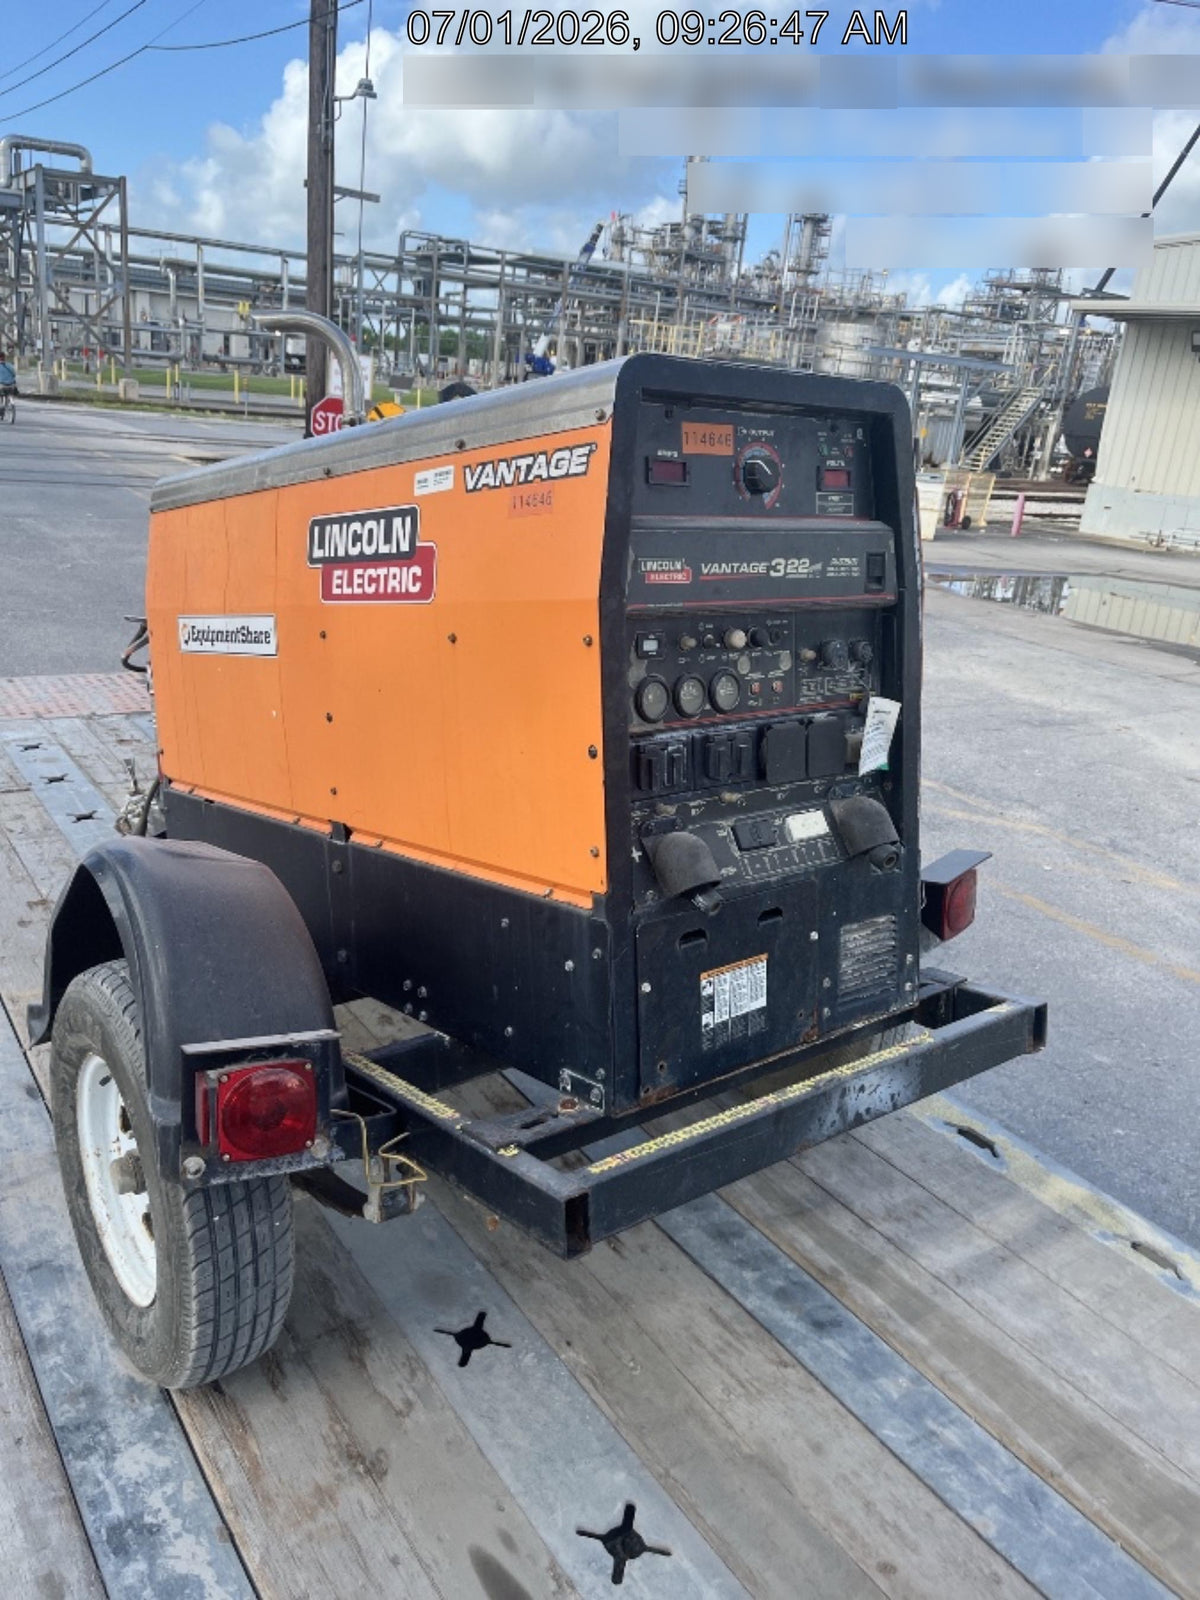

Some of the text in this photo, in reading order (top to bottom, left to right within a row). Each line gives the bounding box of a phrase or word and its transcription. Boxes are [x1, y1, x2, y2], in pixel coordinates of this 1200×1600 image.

[464, 444, 592, 492] VANTAGE
[312, 516, 412, 559] LINCOLN
[641, 560, 683, 572] LINCOLN
[701, 562, 768, 575] VANTAGE
[769, 557, 811, 577] 322
[331, 565, 422, 595] ELECTRIC
[191, 625, 271, 646] EquipmentShare
